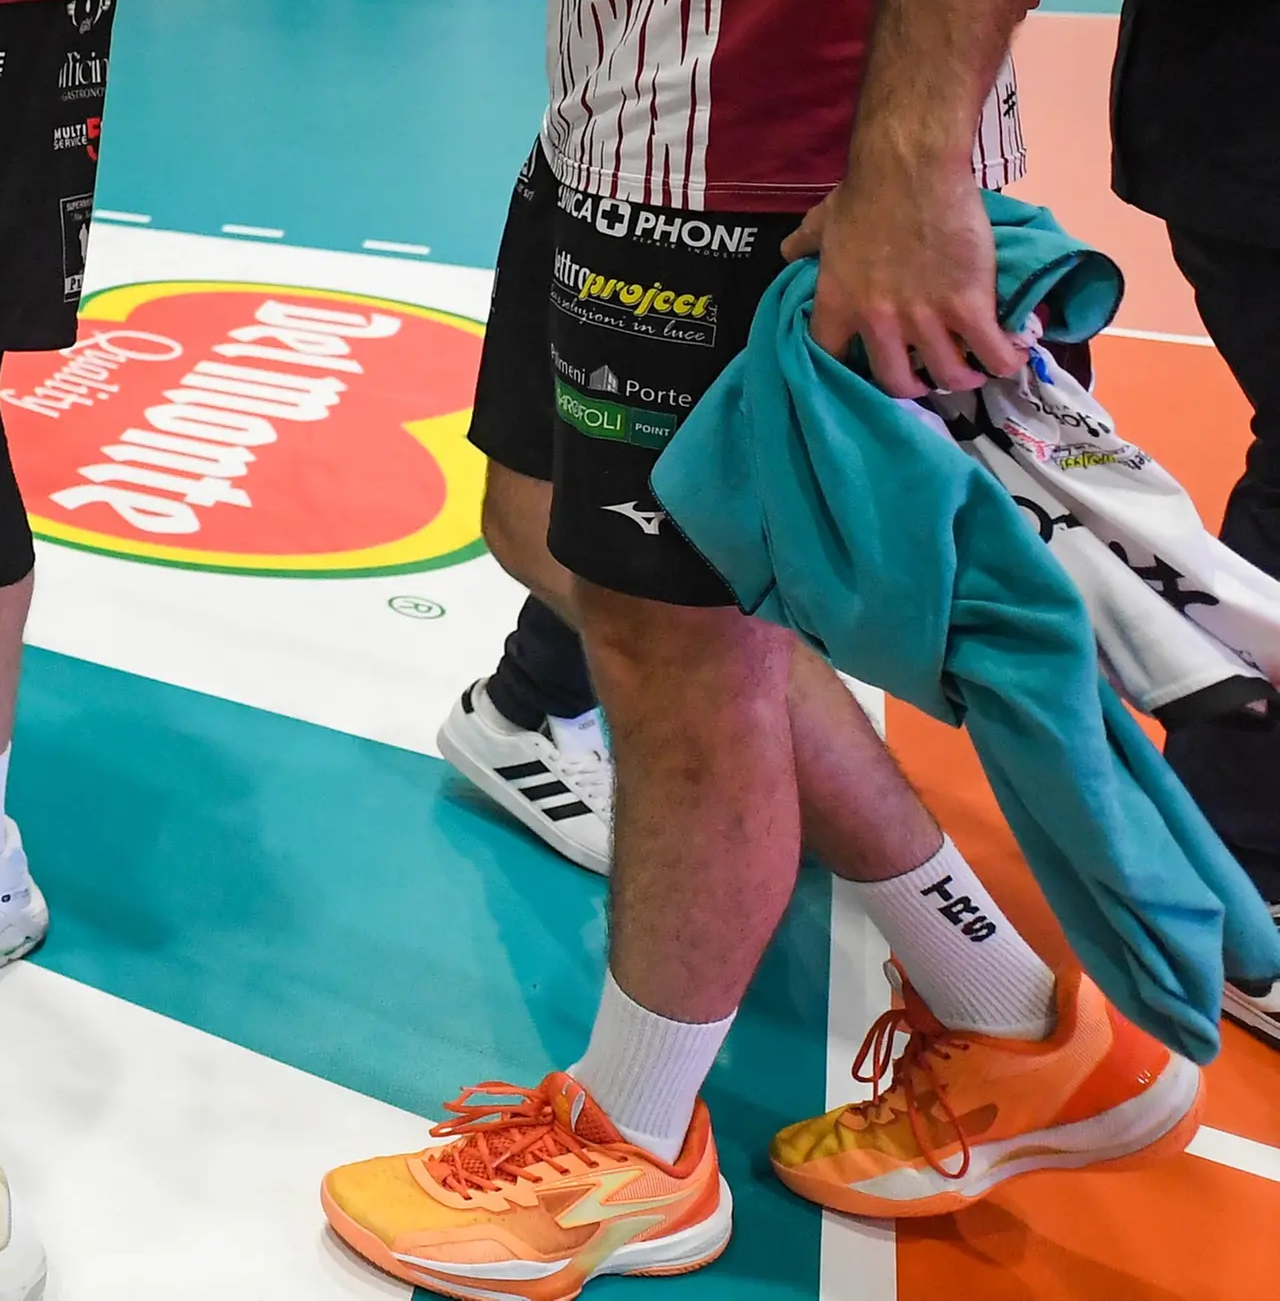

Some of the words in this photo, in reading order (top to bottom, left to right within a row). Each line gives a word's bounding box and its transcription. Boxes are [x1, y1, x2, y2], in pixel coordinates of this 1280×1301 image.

[53, 123, 87, 140] MULTI
[53, 135, 88, 151] SERVICE
[634, 210, 759, 254] PHONE
[663, 319, 707, 342] luce
[625, 379, 693, 408] Porte
[635, 422, 671, 438] POINT
[920, 874, 997, 943] TRS
